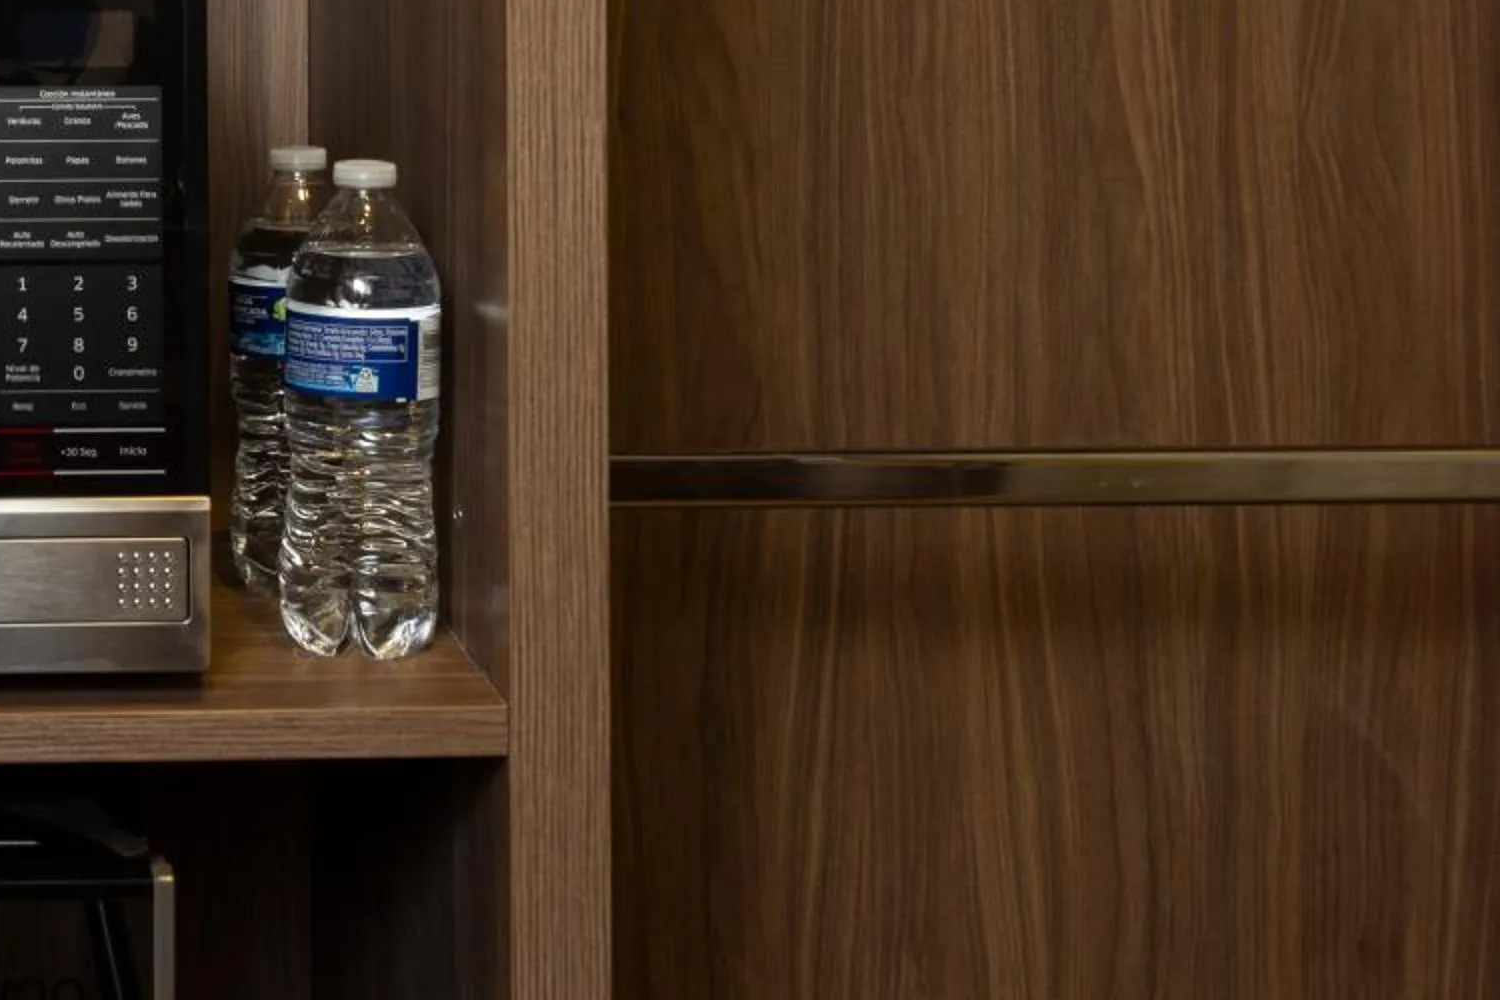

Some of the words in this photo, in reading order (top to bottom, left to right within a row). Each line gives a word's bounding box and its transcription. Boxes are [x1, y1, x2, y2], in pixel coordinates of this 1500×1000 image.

[18, 276, 28, 292] 1
[73, 275, 85, 291] 2
[126, 275, 138, 291] 3
[16, 307, 28, 323] 4
[73, 306, 85, 322] 5
[126, 306, 138, 322] 6
[16, 337, 29, 353] 7
[73, 337, 85, 353] 8
[126, 336, 138, 352] 9
[73, 365, 85, 381] 0
